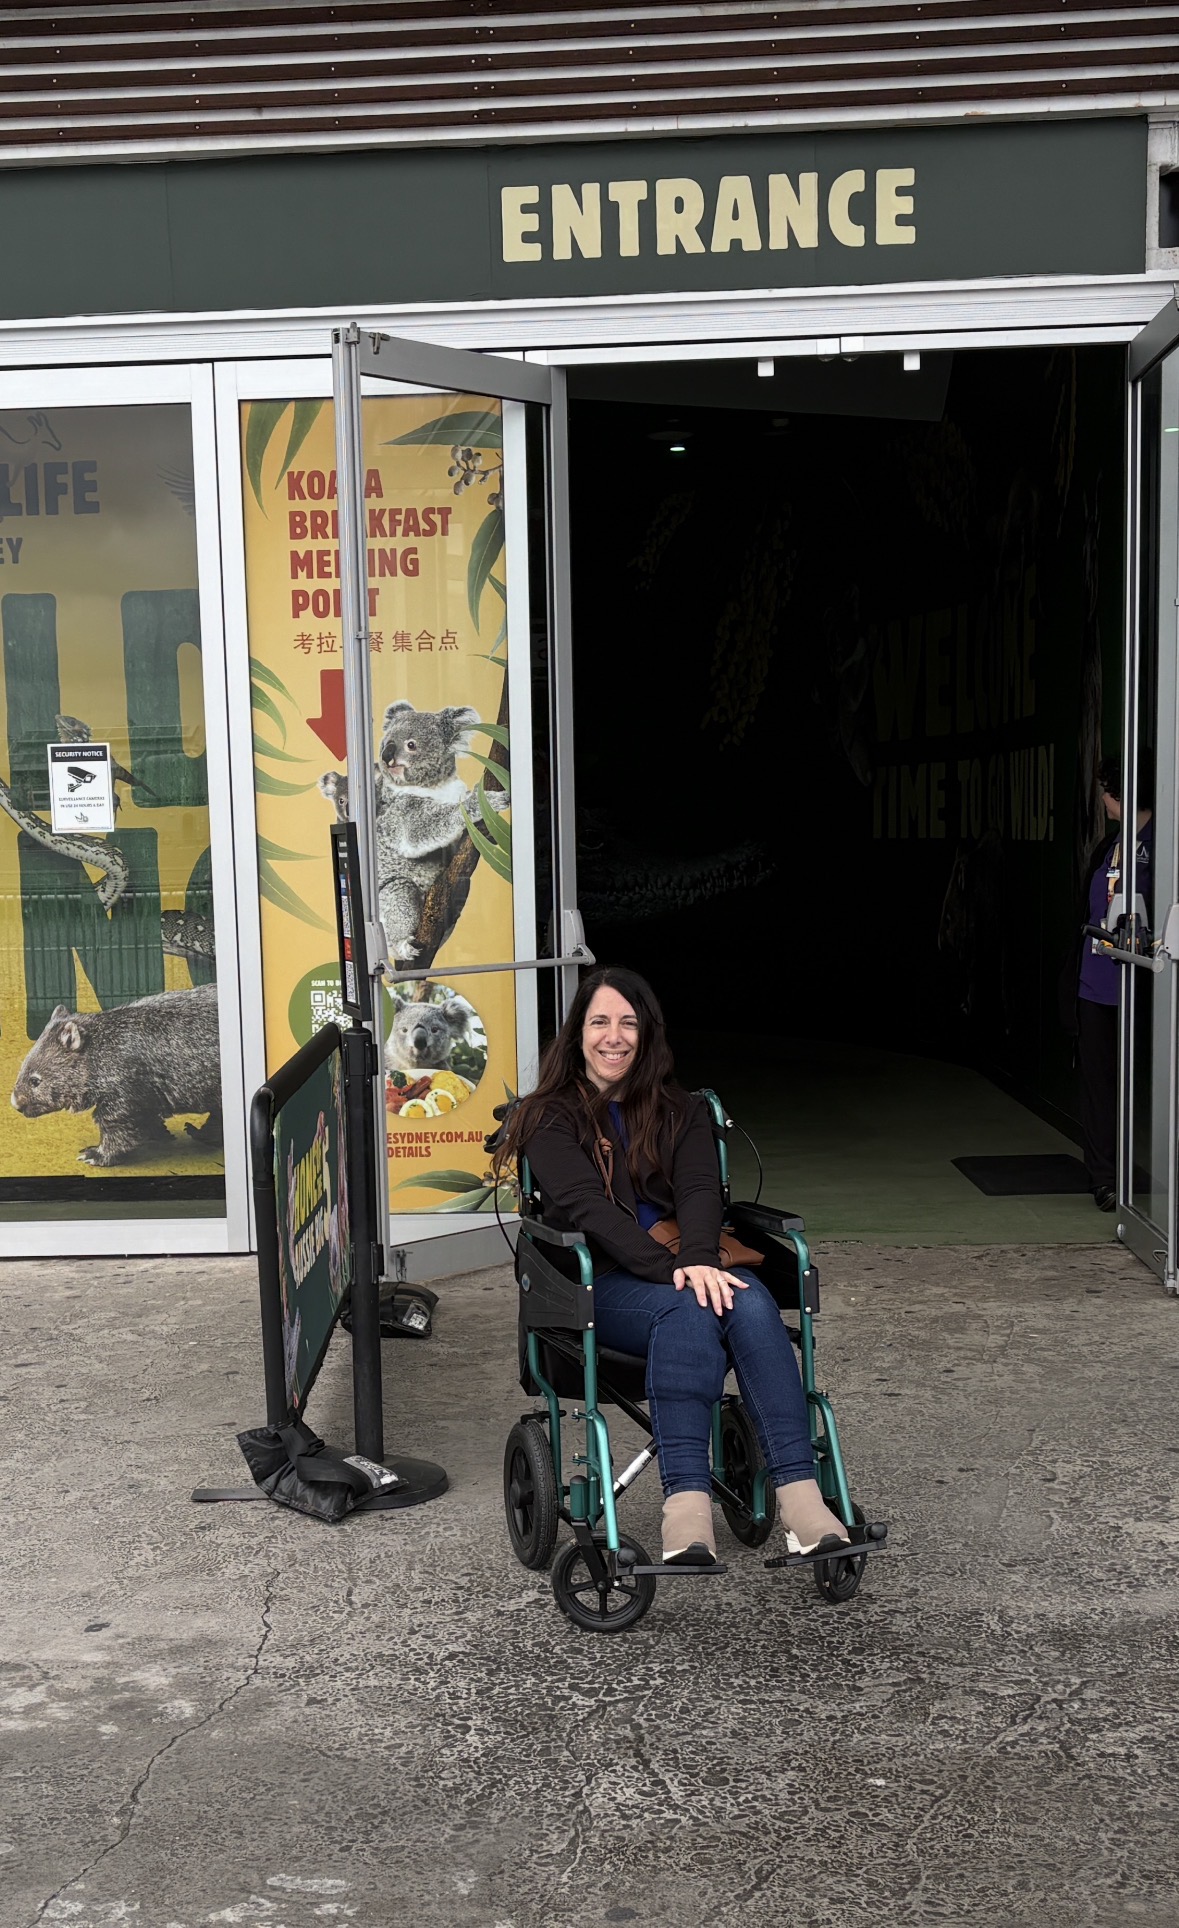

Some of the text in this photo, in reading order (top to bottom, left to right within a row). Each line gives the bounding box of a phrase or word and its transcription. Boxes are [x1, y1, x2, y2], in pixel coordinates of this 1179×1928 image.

[501, 168, 916, 262] ENTRANCE
[0, 461, 100, 516] LIFE
[289, 507, 452, 540] BRKFAST
[290, 547, 419, 579] MEING
[291, 588, 379, 619] POIT
[392, 629, 459, 652] 集合点
[873, 762, 946, 839] TIME
[957, 758, 982, 839] TO
[387, 1131, 483, 1144] ESYDNEY.COM.AU
[387, 1146, 431, 1158] DETAILS
